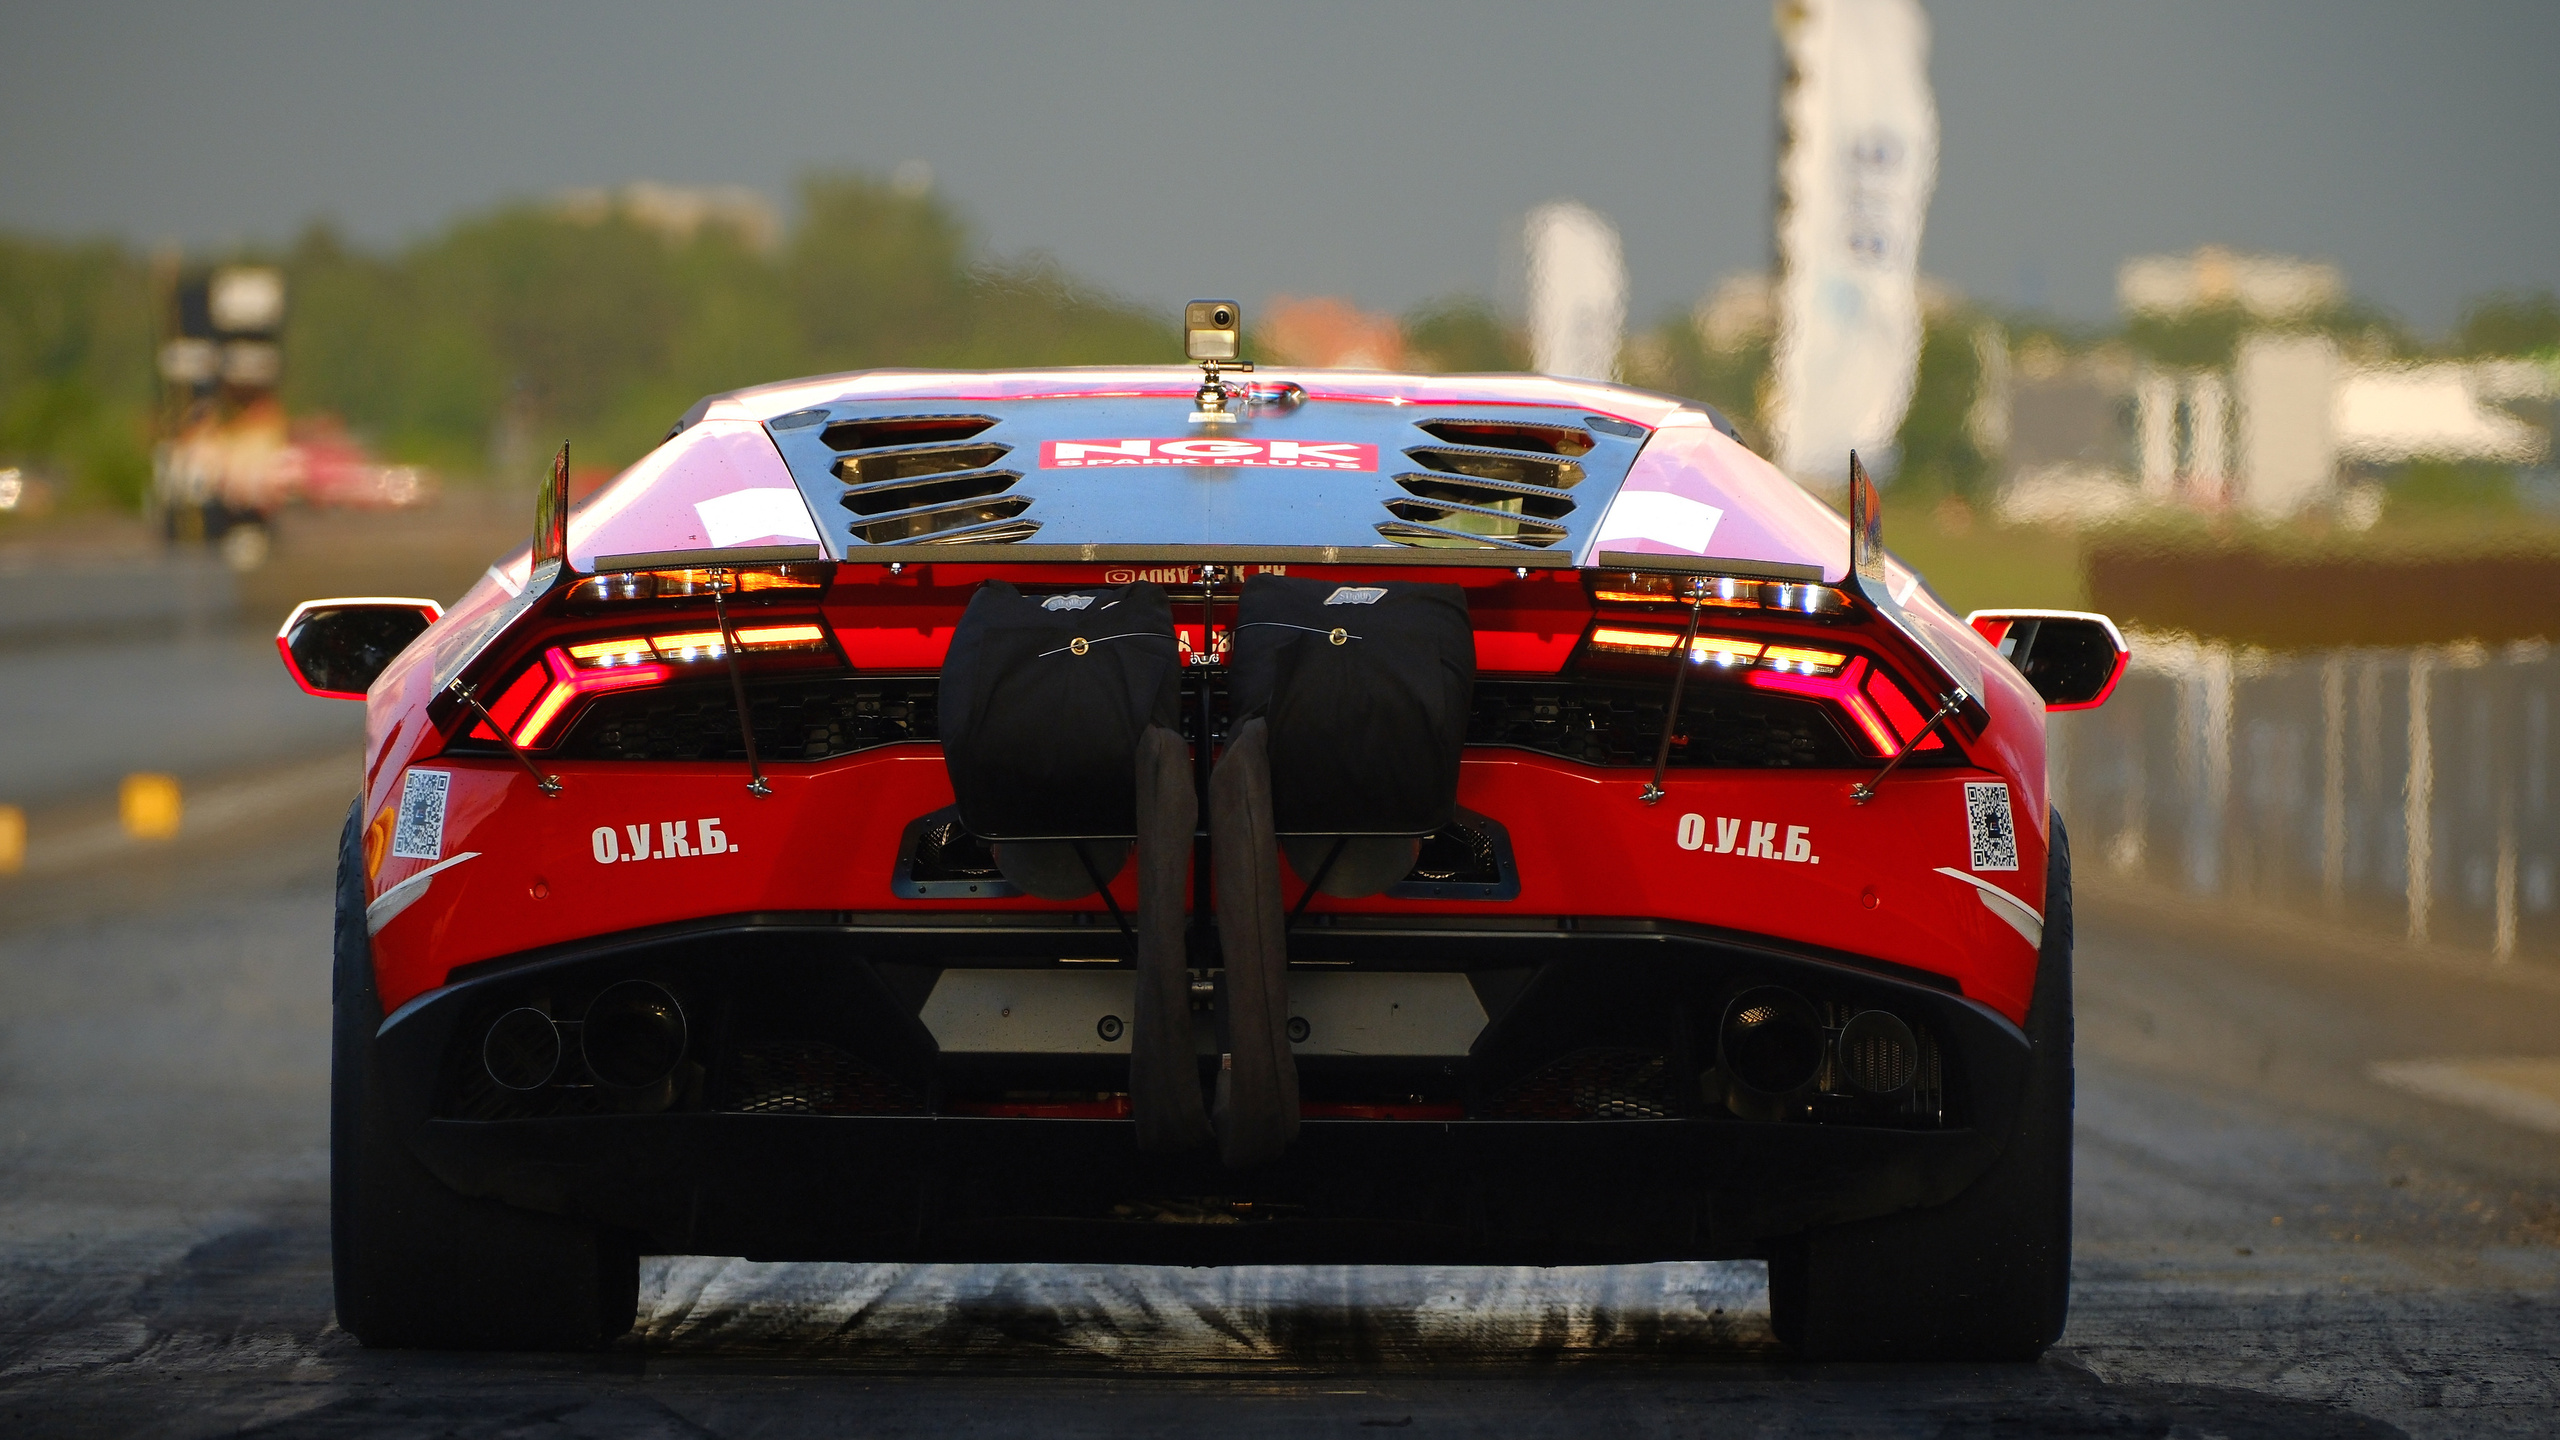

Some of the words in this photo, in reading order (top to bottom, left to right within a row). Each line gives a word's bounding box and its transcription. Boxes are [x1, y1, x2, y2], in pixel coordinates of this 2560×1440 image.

[1055, 440, 1362, 462] NGK
[1057, 458, 1201, 466] SPARK
[1214, 458, 1361, 469] PLUGS
[592, 818, 739, 864] О.У.К.Б.
[1676, 812, 1820, 865] О.У.К.Б.
